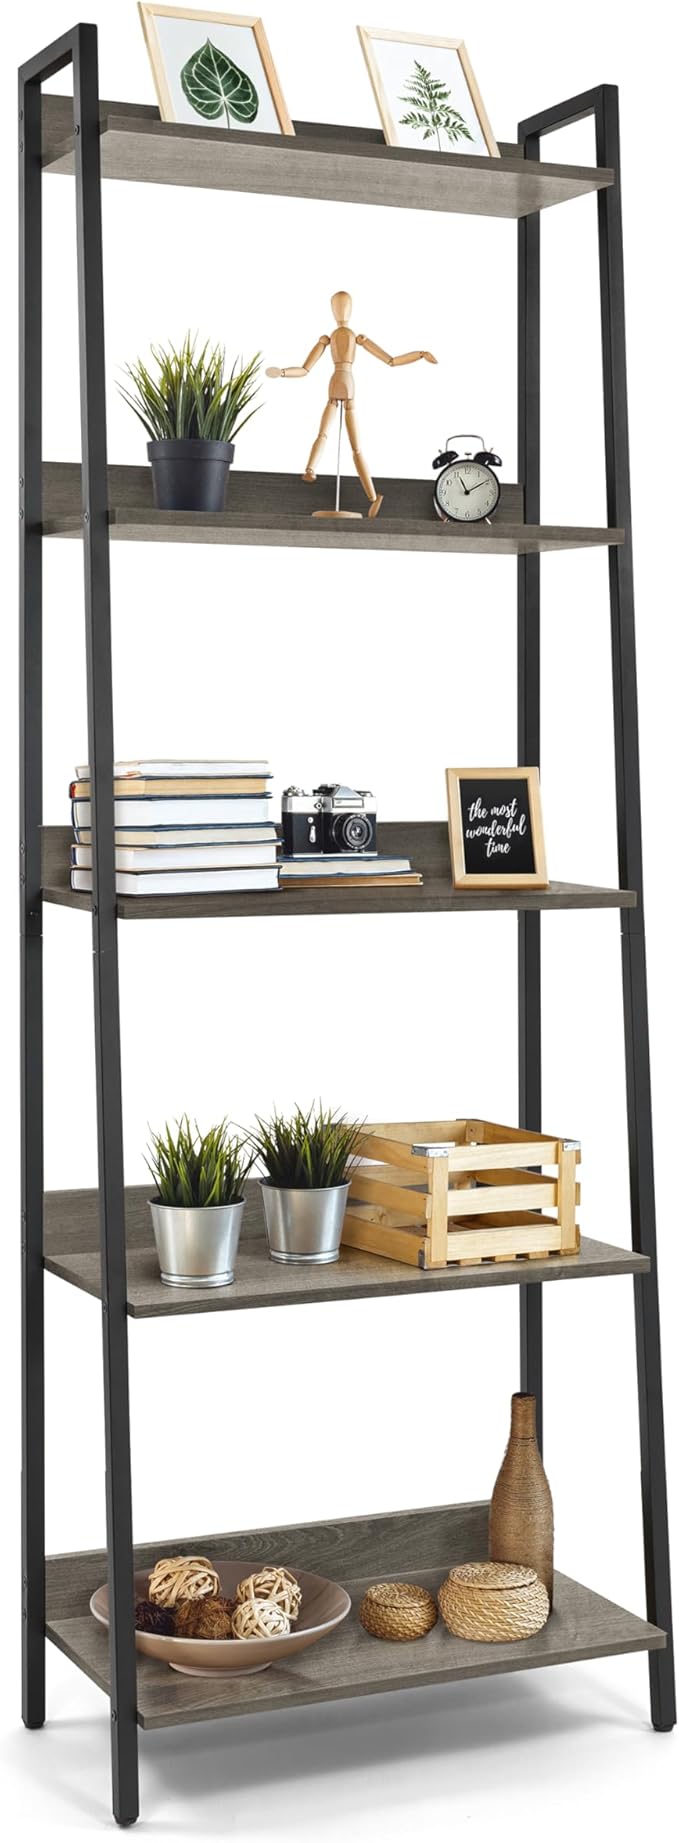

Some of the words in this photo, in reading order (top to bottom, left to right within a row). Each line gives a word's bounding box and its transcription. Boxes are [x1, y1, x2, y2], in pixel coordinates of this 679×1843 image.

[464, 467, 472, 475] 12
[467, 797, 488, 822] the
[490, 798, 518, 818] most
[465, 814, 527, 839] wonderful
[484, 837, 511, 858] time
